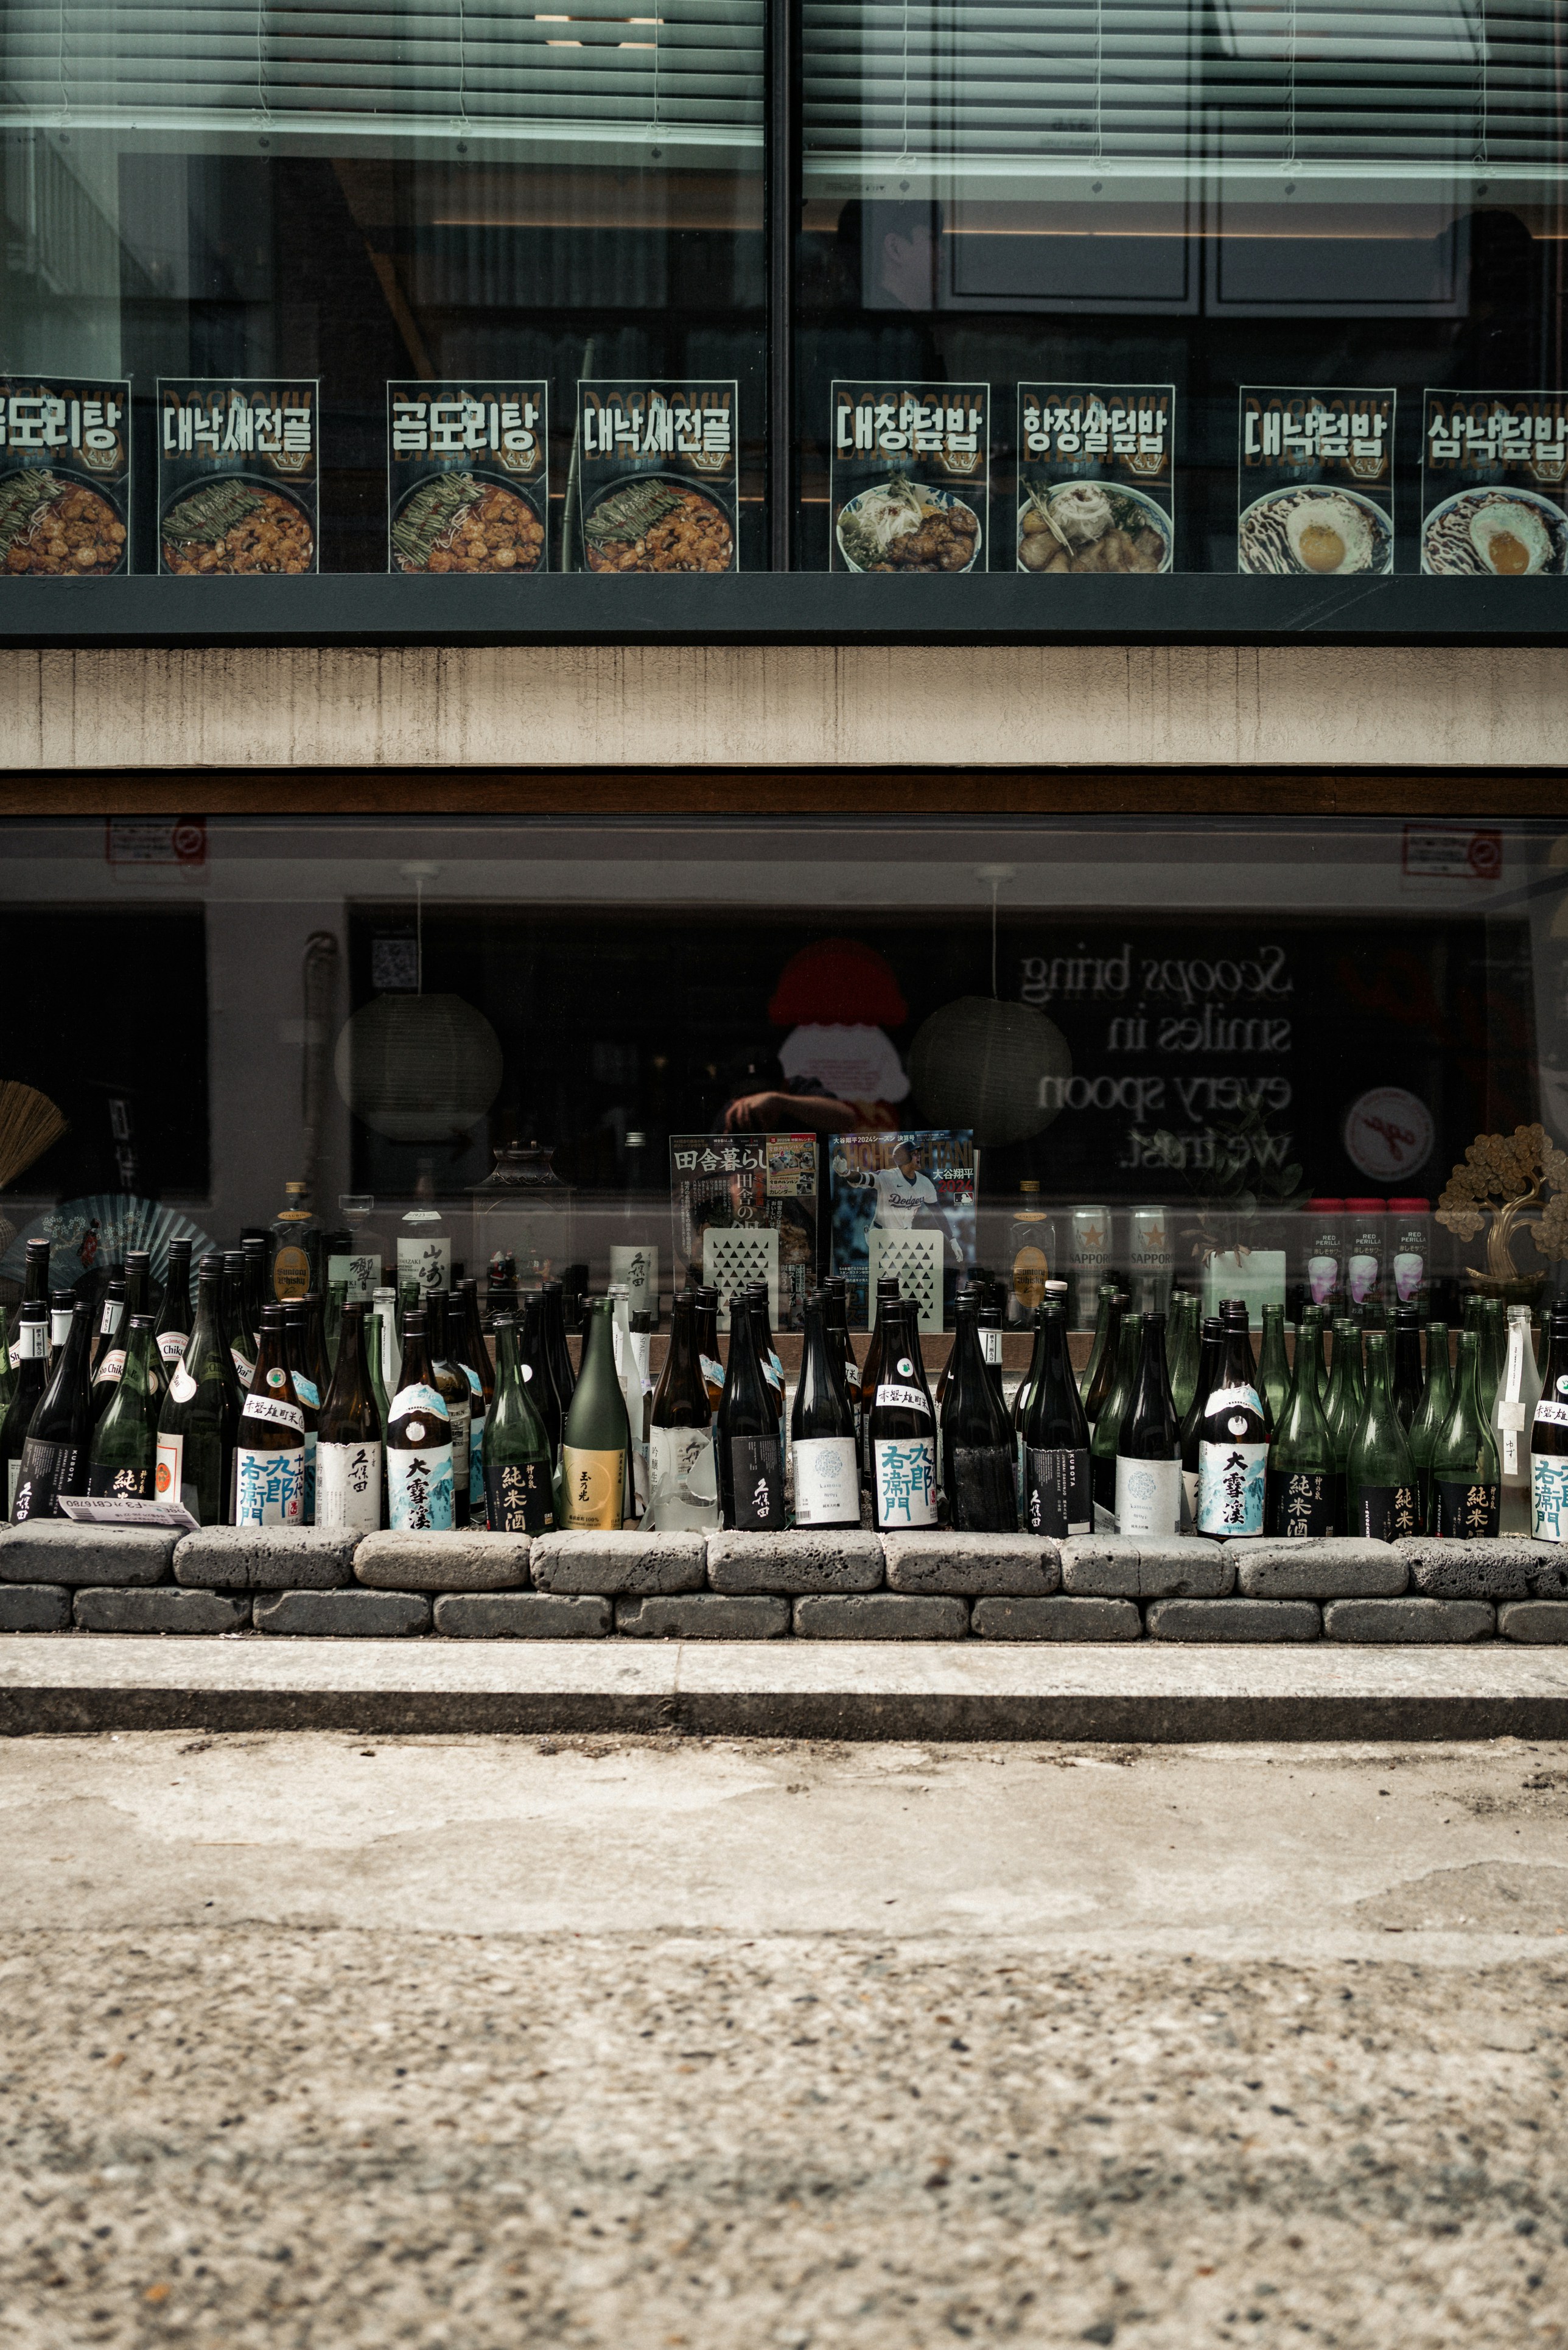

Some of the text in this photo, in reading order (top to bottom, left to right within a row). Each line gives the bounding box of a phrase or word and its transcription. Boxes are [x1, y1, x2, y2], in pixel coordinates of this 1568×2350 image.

[0, 397, 122, 449] 도리탕
[163, 407, 311, 451] 대낙새전골
[393, 402, 539, 451] 곱도리탕
[584, 408, 730, 452] 대낙새전골
[837, 405, 983, 452] 대창덮밥
[1023, 407, 1167, 454] 항정살덮밥
[1245, 412, 1388, 457] 대낙덮밥
[1427, 415, 1568, 461] 삼낙덮밥
[674, 1147, 767, 1172] 田舎暮らし
[933, 1168, 974, 1180] 大谷翔平
[888, 1193, 925, 1210] Dodgers
[938, 1180, 974, 1193] 2024
[277, 1268, 306, 1277] Suntory
[278, 1277, 306, 1286] Whisky
[628, 1252, 645, 1287] 久保田
[1017, 1276, 1044, 1285] Whisky
[1018, 1268, 1045, 1277] Suntory
[67, 1450, 78, 1483] KUBOTA
[348, 1448, 369, 1493] 久保田
[1506, 1440, 1515, 1458] ゆず
[240, 1455, 268, 1526] 右衛門
[266, 1455, 296, 1518] 九郎
[578, 1471, 592, 1502] 玉乃光
[881, 1446, 912, 1521] 右衛門
[909, 1443, 933, 1506] 九郎
[17, 1481, 33, 1521] 久保田
[501, 1467, 527, 1531] 純米酒
[752, 1478, 770, 1518] 久保田
[1029, 1489, 1041, 1528] 久保田
[1287, 1474, 1312, 1537] 純米酒
[1535, 1460, 1564, 1537] 右衛門
